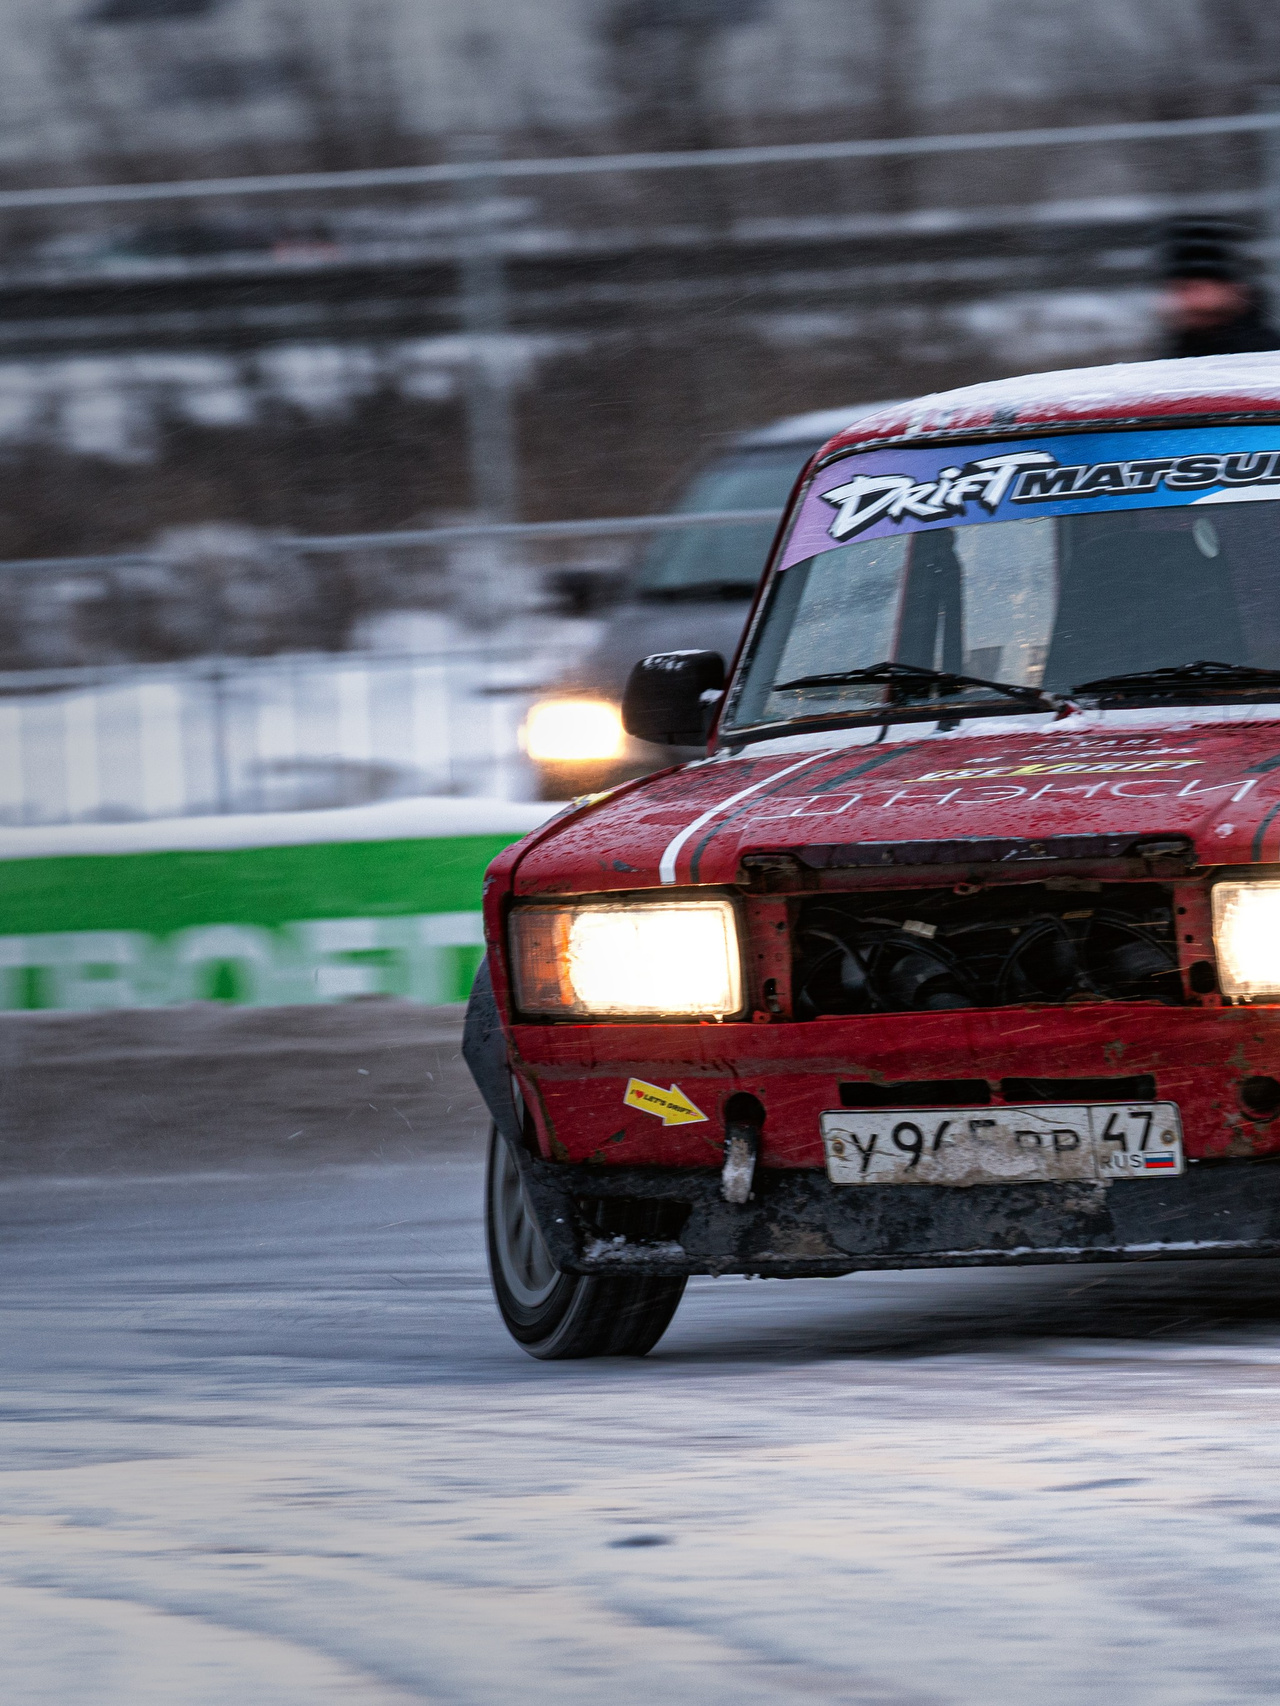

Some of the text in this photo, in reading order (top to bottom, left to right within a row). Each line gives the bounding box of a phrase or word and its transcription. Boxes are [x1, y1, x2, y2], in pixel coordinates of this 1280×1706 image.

[643, 1094, 667, 1106] LET'S
[666, 1102, 692, 1115] DRIFT
[1102, 1110, 1154, 1153] 47
[1098, 1154, 1142, 1170] RUS
